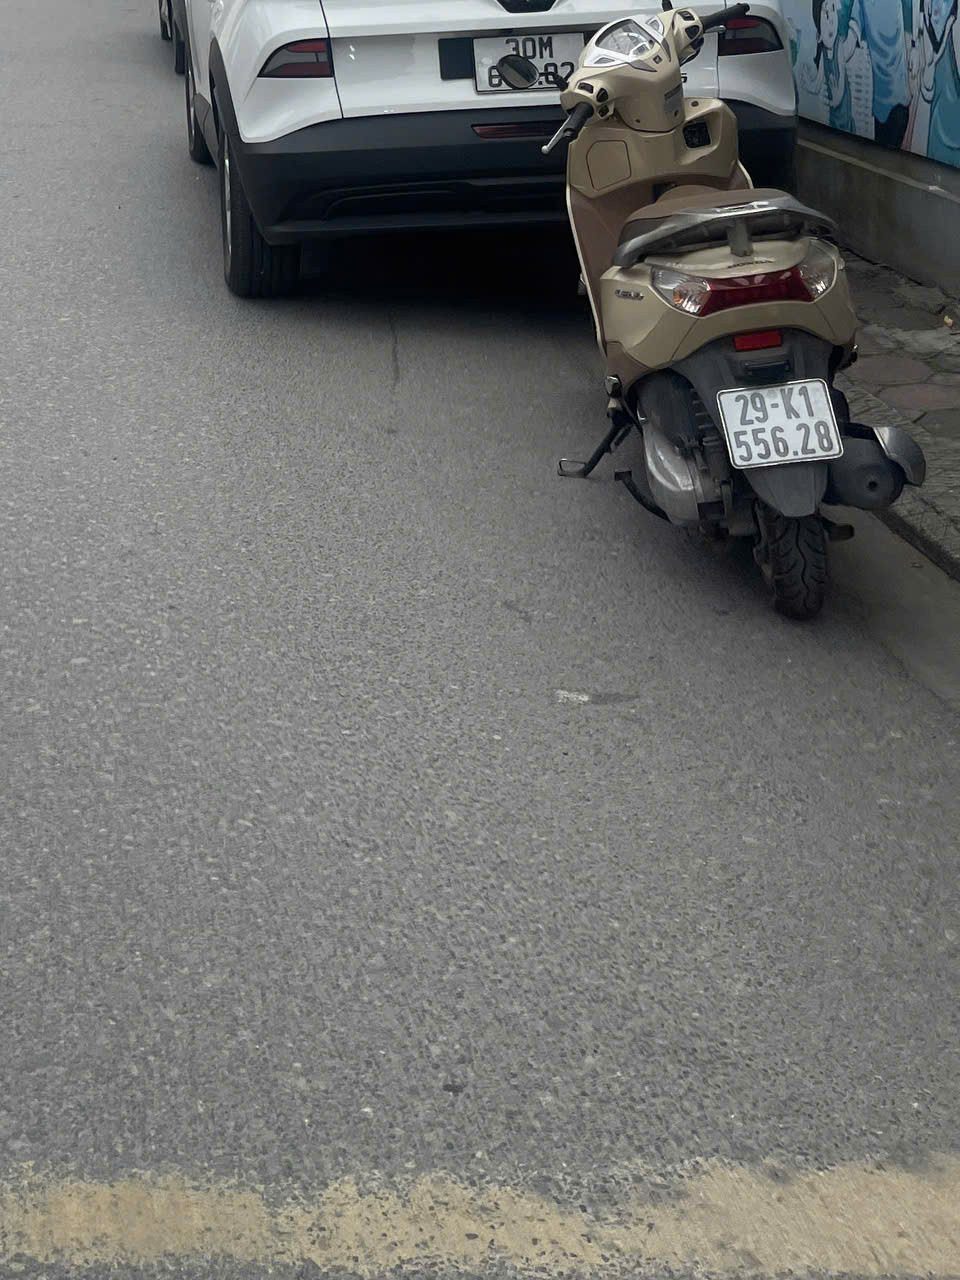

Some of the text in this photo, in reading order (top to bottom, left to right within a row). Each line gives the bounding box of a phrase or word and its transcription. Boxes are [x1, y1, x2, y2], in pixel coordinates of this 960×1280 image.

[505, 36, 553, 59] 30M
[735, 385, 814, 426] 29-K1
[733, 421, 833, 462] 556.28
